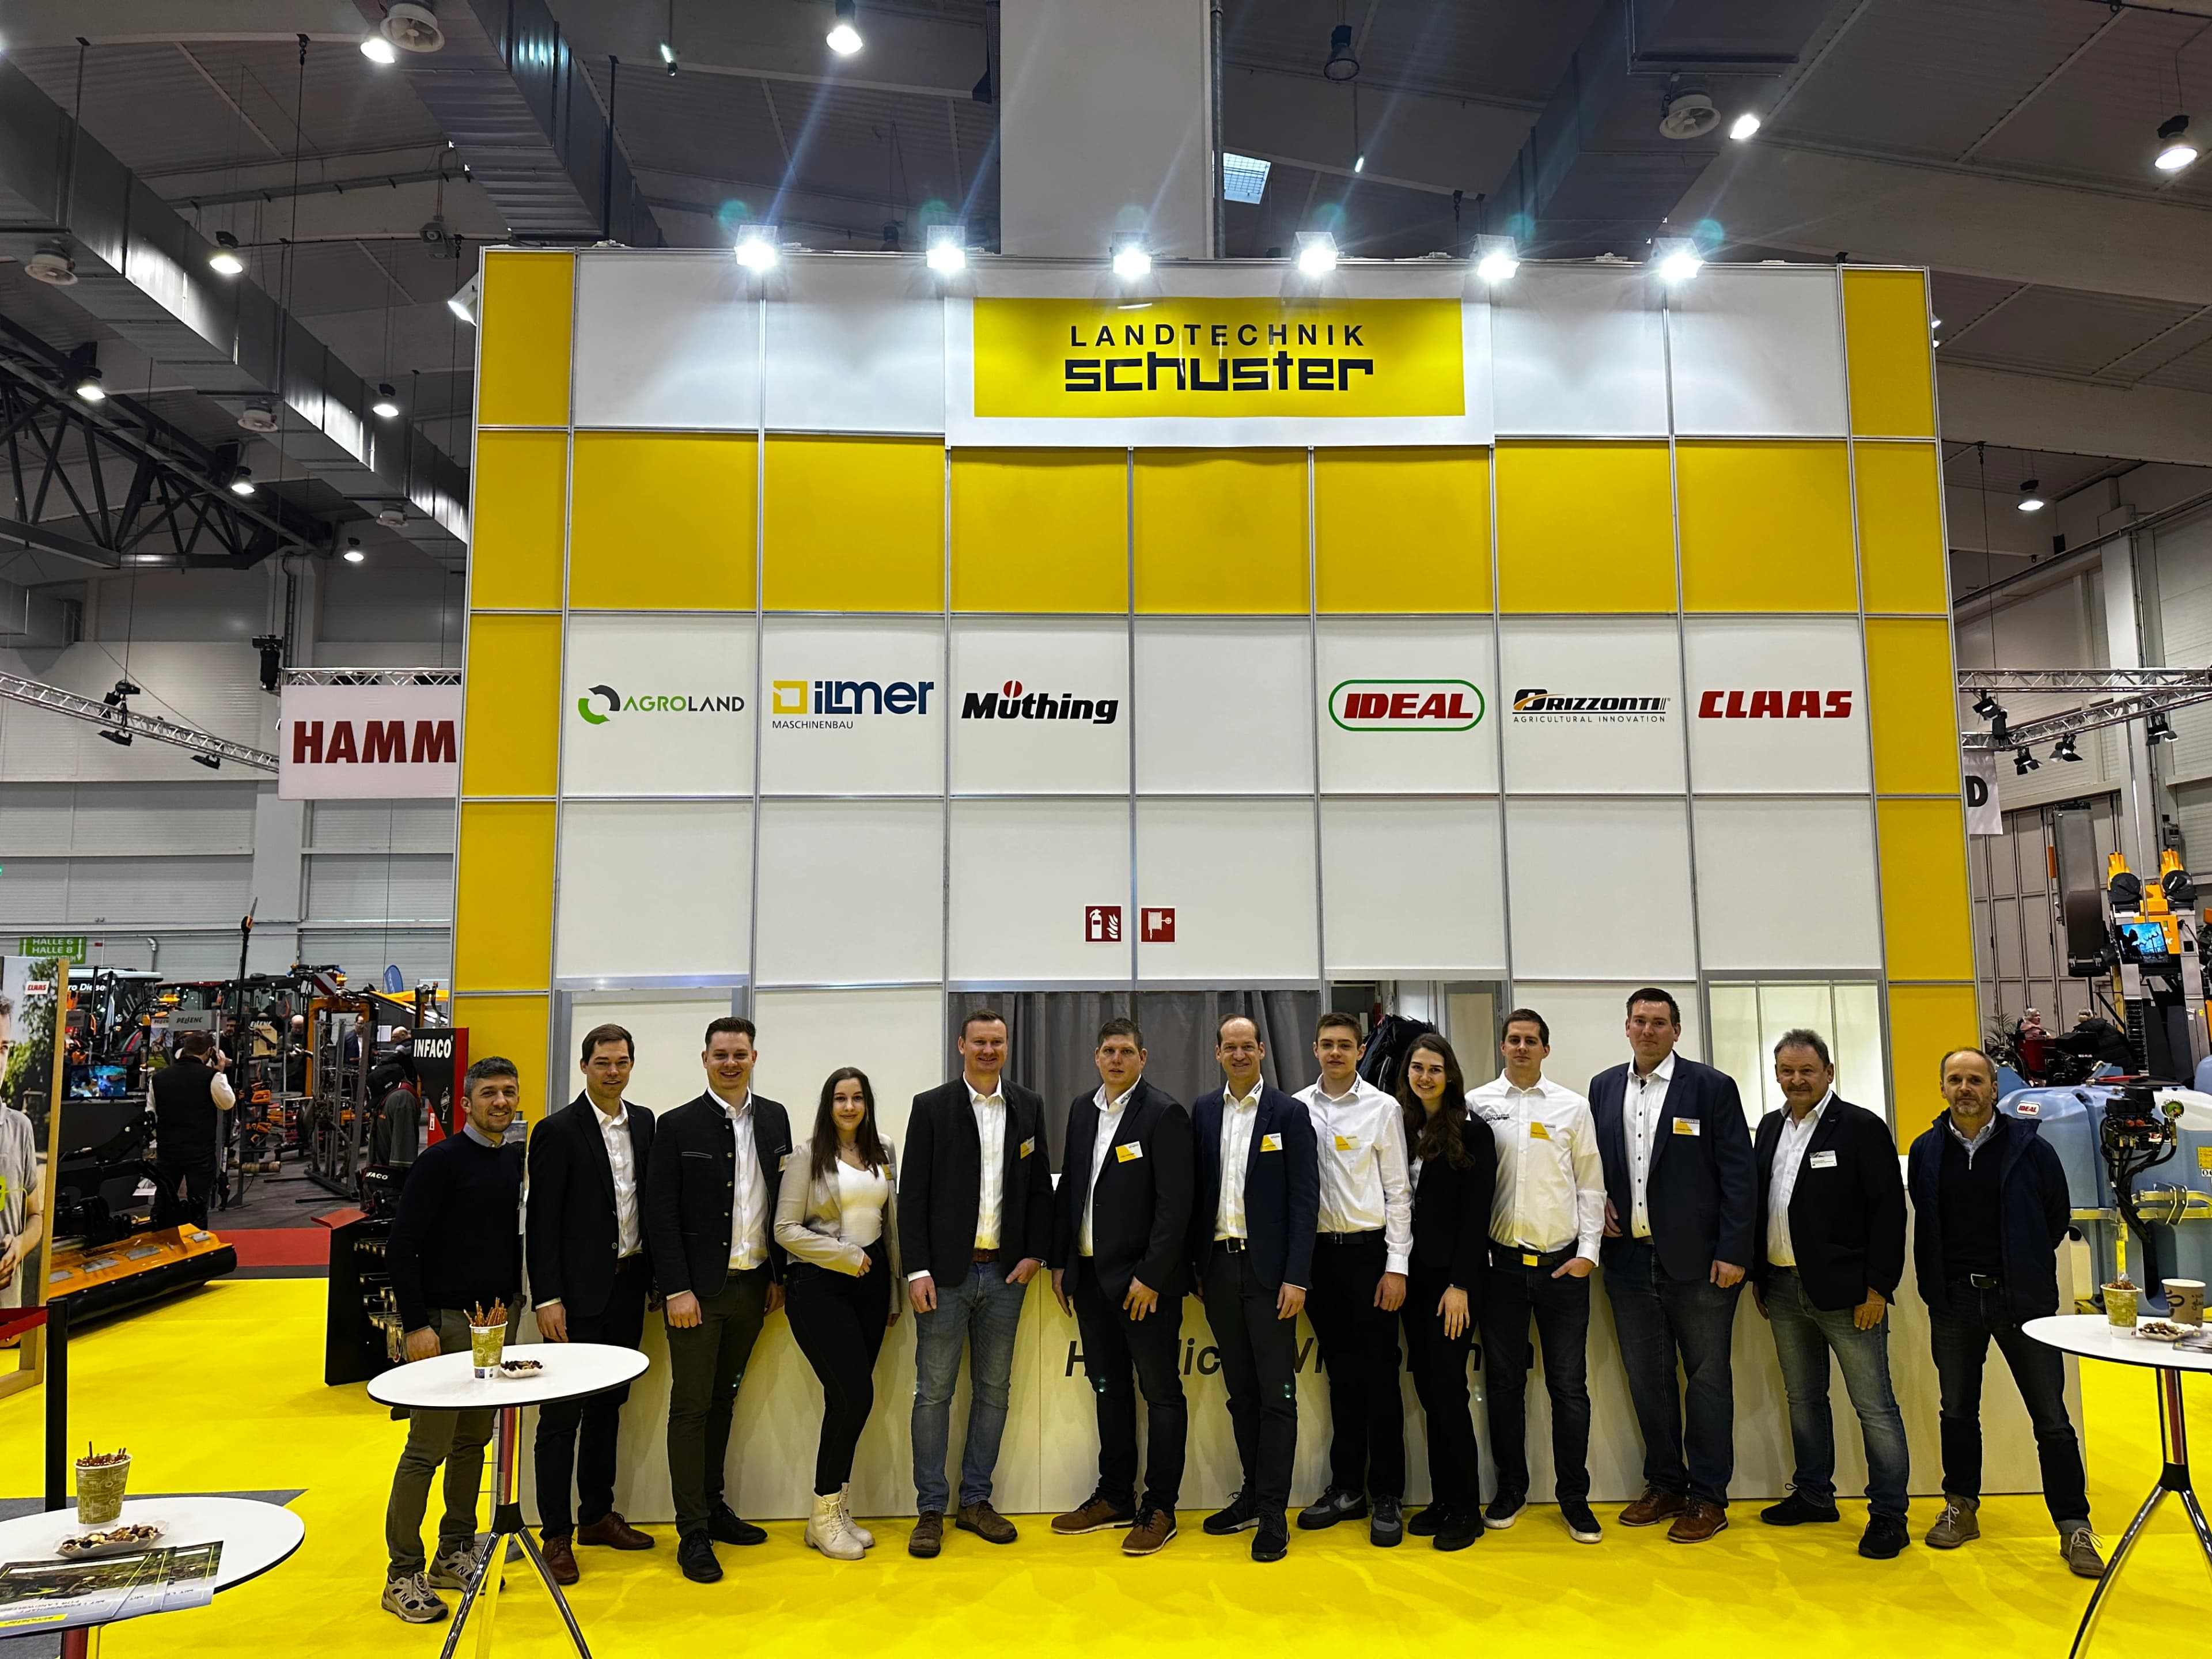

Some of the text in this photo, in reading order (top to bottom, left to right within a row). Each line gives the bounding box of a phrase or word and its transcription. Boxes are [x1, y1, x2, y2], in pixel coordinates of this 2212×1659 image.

[1070, 324, 1365, 346] LANDTECHNIK
[1065, 351, 1374, 392] schuster
[623, 695, 744, 712] AGROLAND
[961, 680, 1119, 724] Müthing
[1343, 693, 1474, 719] IDEAL
[1698, 690, 1853, 718] CLAAS
[772, 720, 854, 730] MASCHINENBAU
[293, 720, 457, 763] HAMM
[413, 1039, 452, 1059] INFACO
